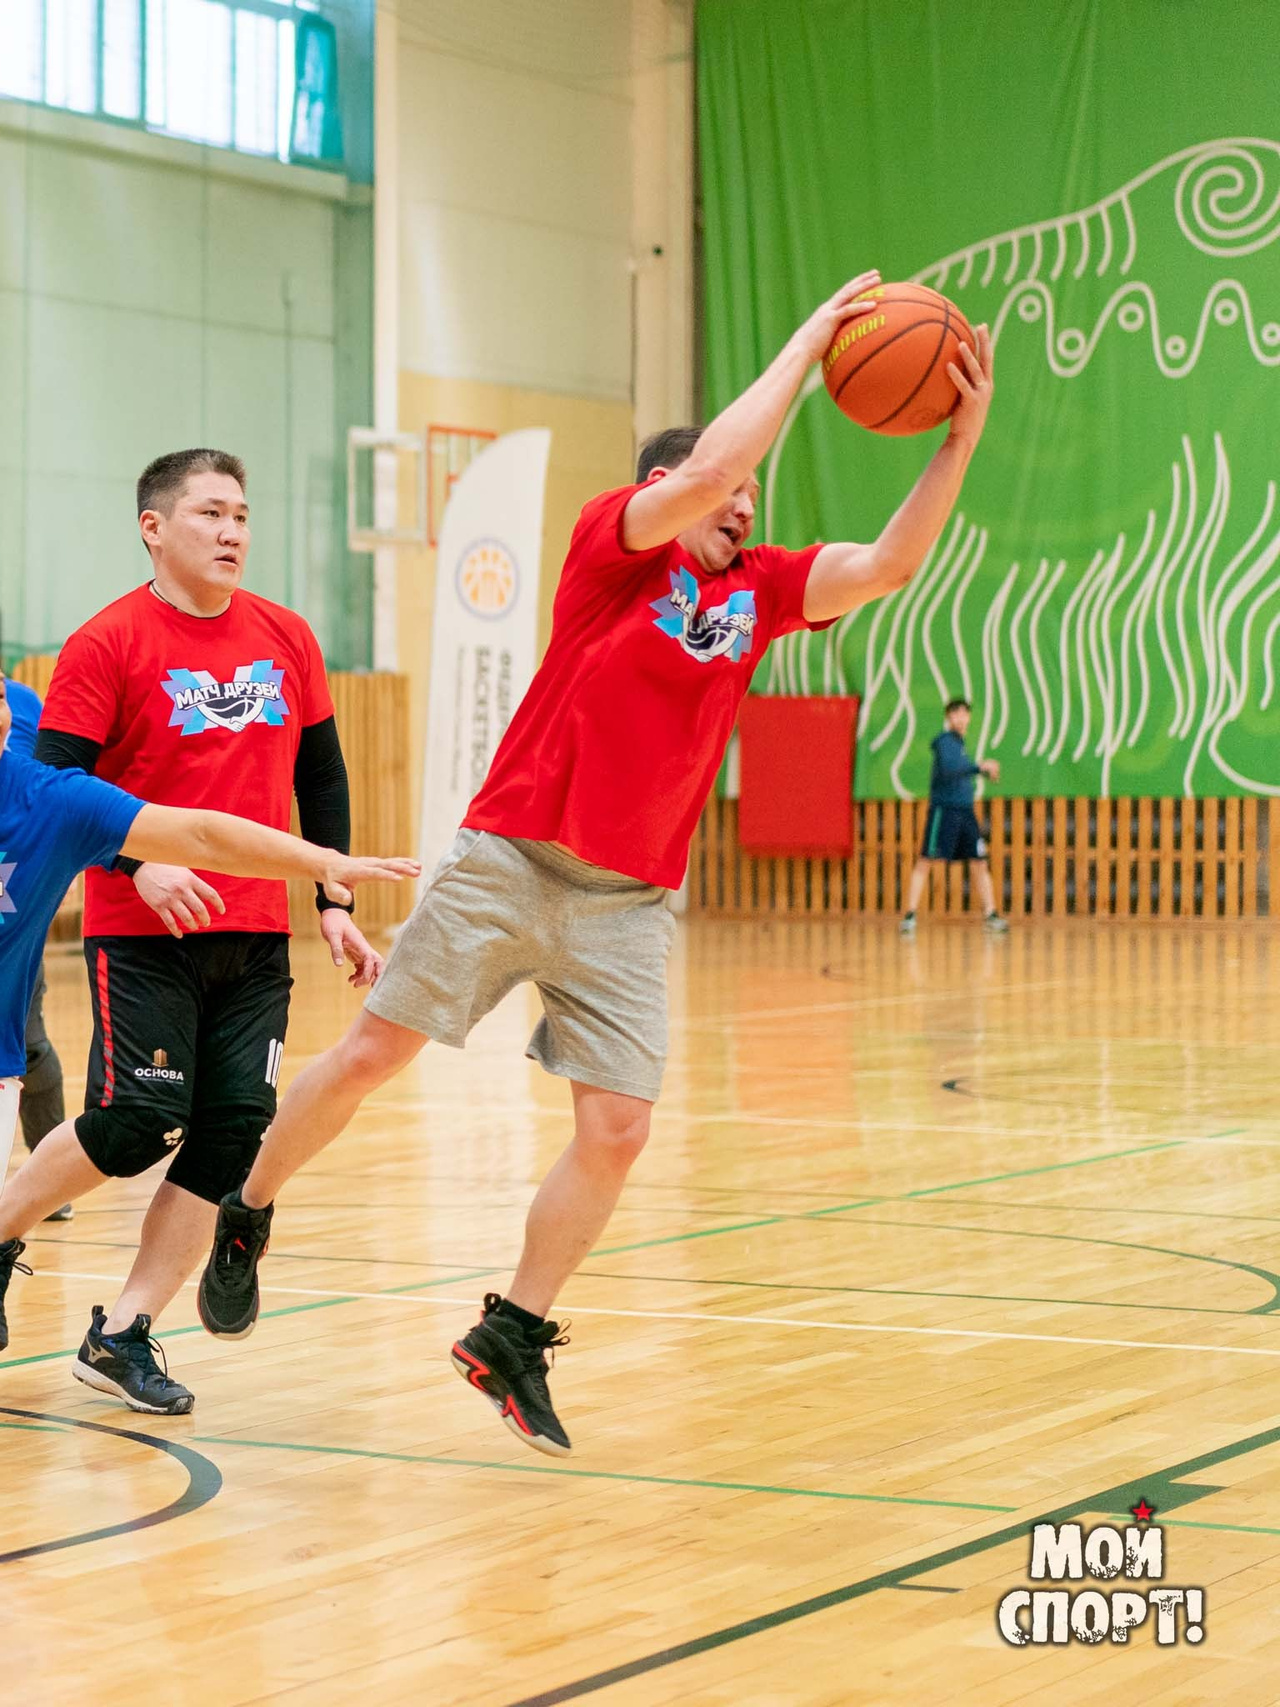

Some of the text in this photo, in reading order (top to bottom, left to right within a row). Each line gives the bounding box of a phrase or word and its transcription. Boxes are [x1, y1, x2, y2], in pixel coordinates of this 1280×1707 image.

[174, 681, 280, 710] МАТЧ ДРУЗЕЙ
[134, 1067, 184, 1081] ОСНОВА
